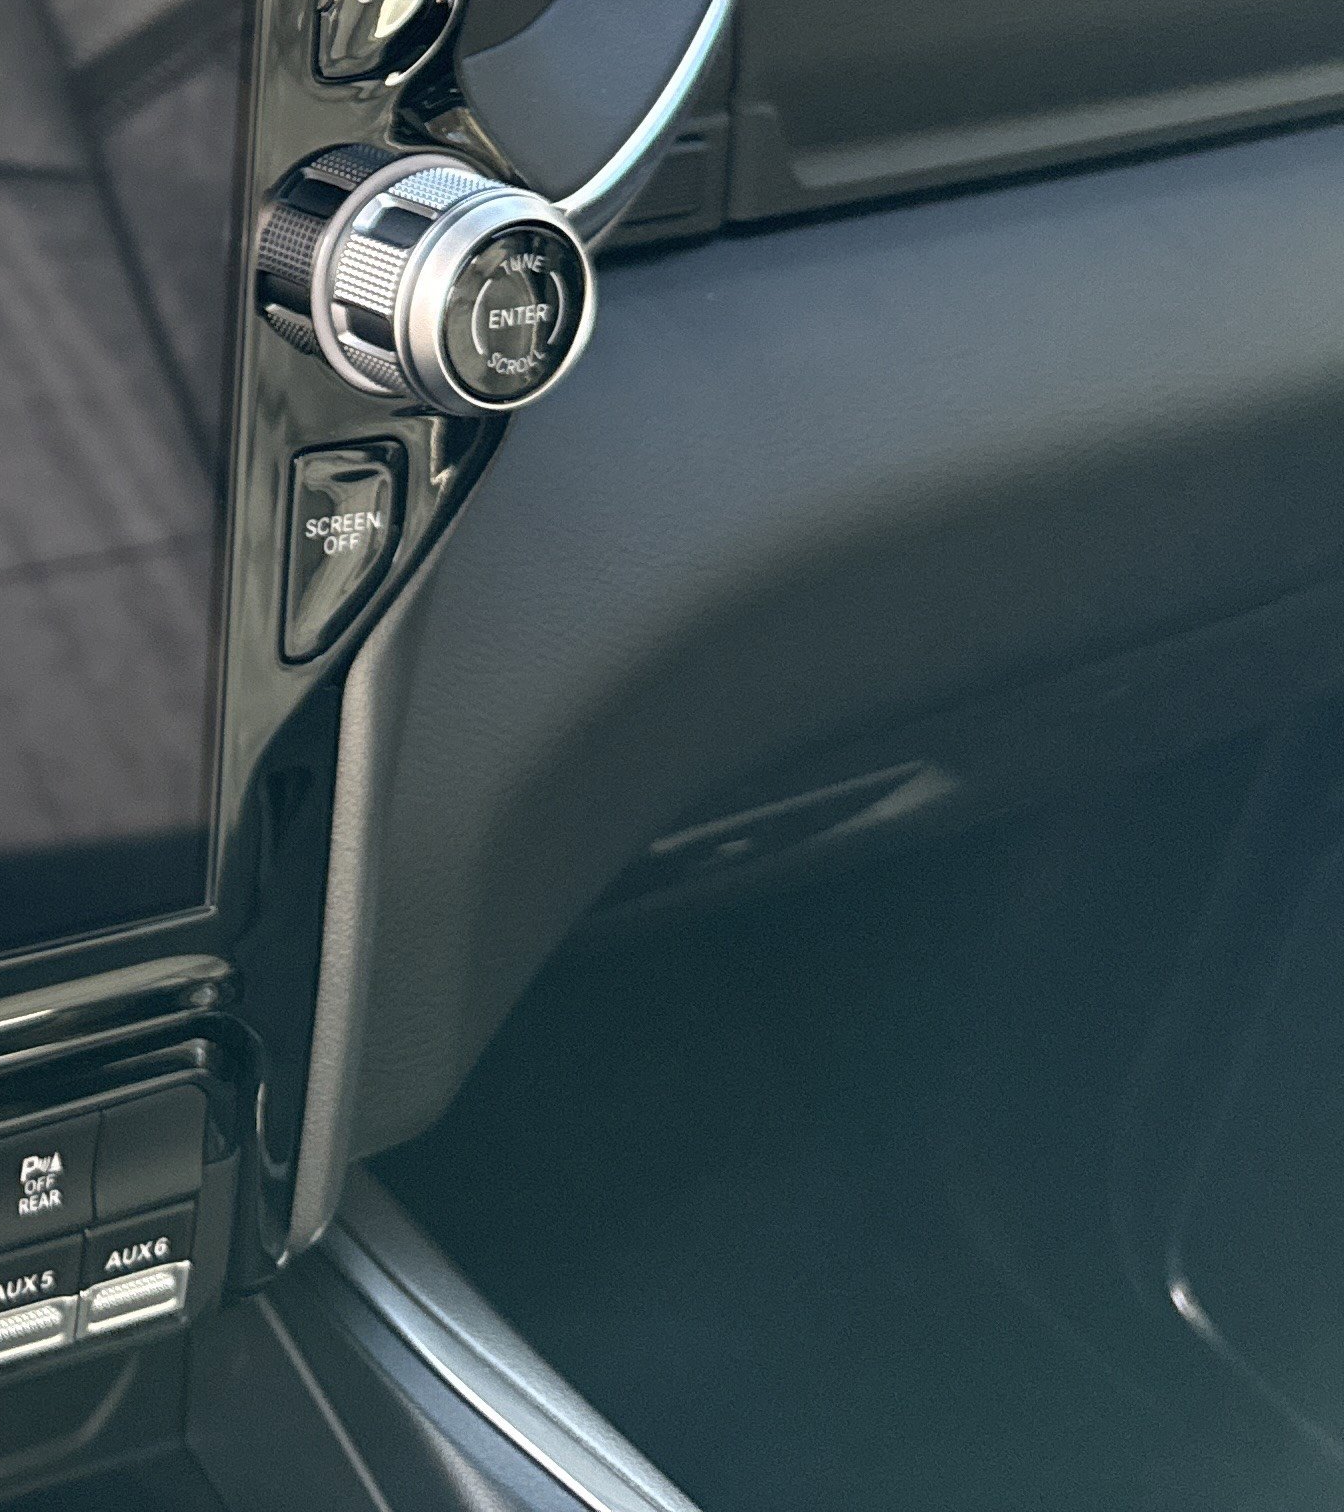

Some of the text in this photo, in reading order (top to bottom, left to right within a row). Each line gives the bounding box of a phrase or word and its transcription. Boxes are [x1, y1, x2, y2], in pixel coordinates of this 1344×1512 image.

[499, 253, 545, 276] TUNE
[488, 303, 549, 329] ENTER
[487, 350, 546, 375] SCROLL
[305, 511, 381, 539] SCREEN
[323, 533, 361, 555] OFF
[24, 1175, 57, 1195] OFF
[18, 1188, 62, 1216] REAR
[105, 1236, 171, 1272] AUX 6
[39, 1270, 56, 1290] 5
